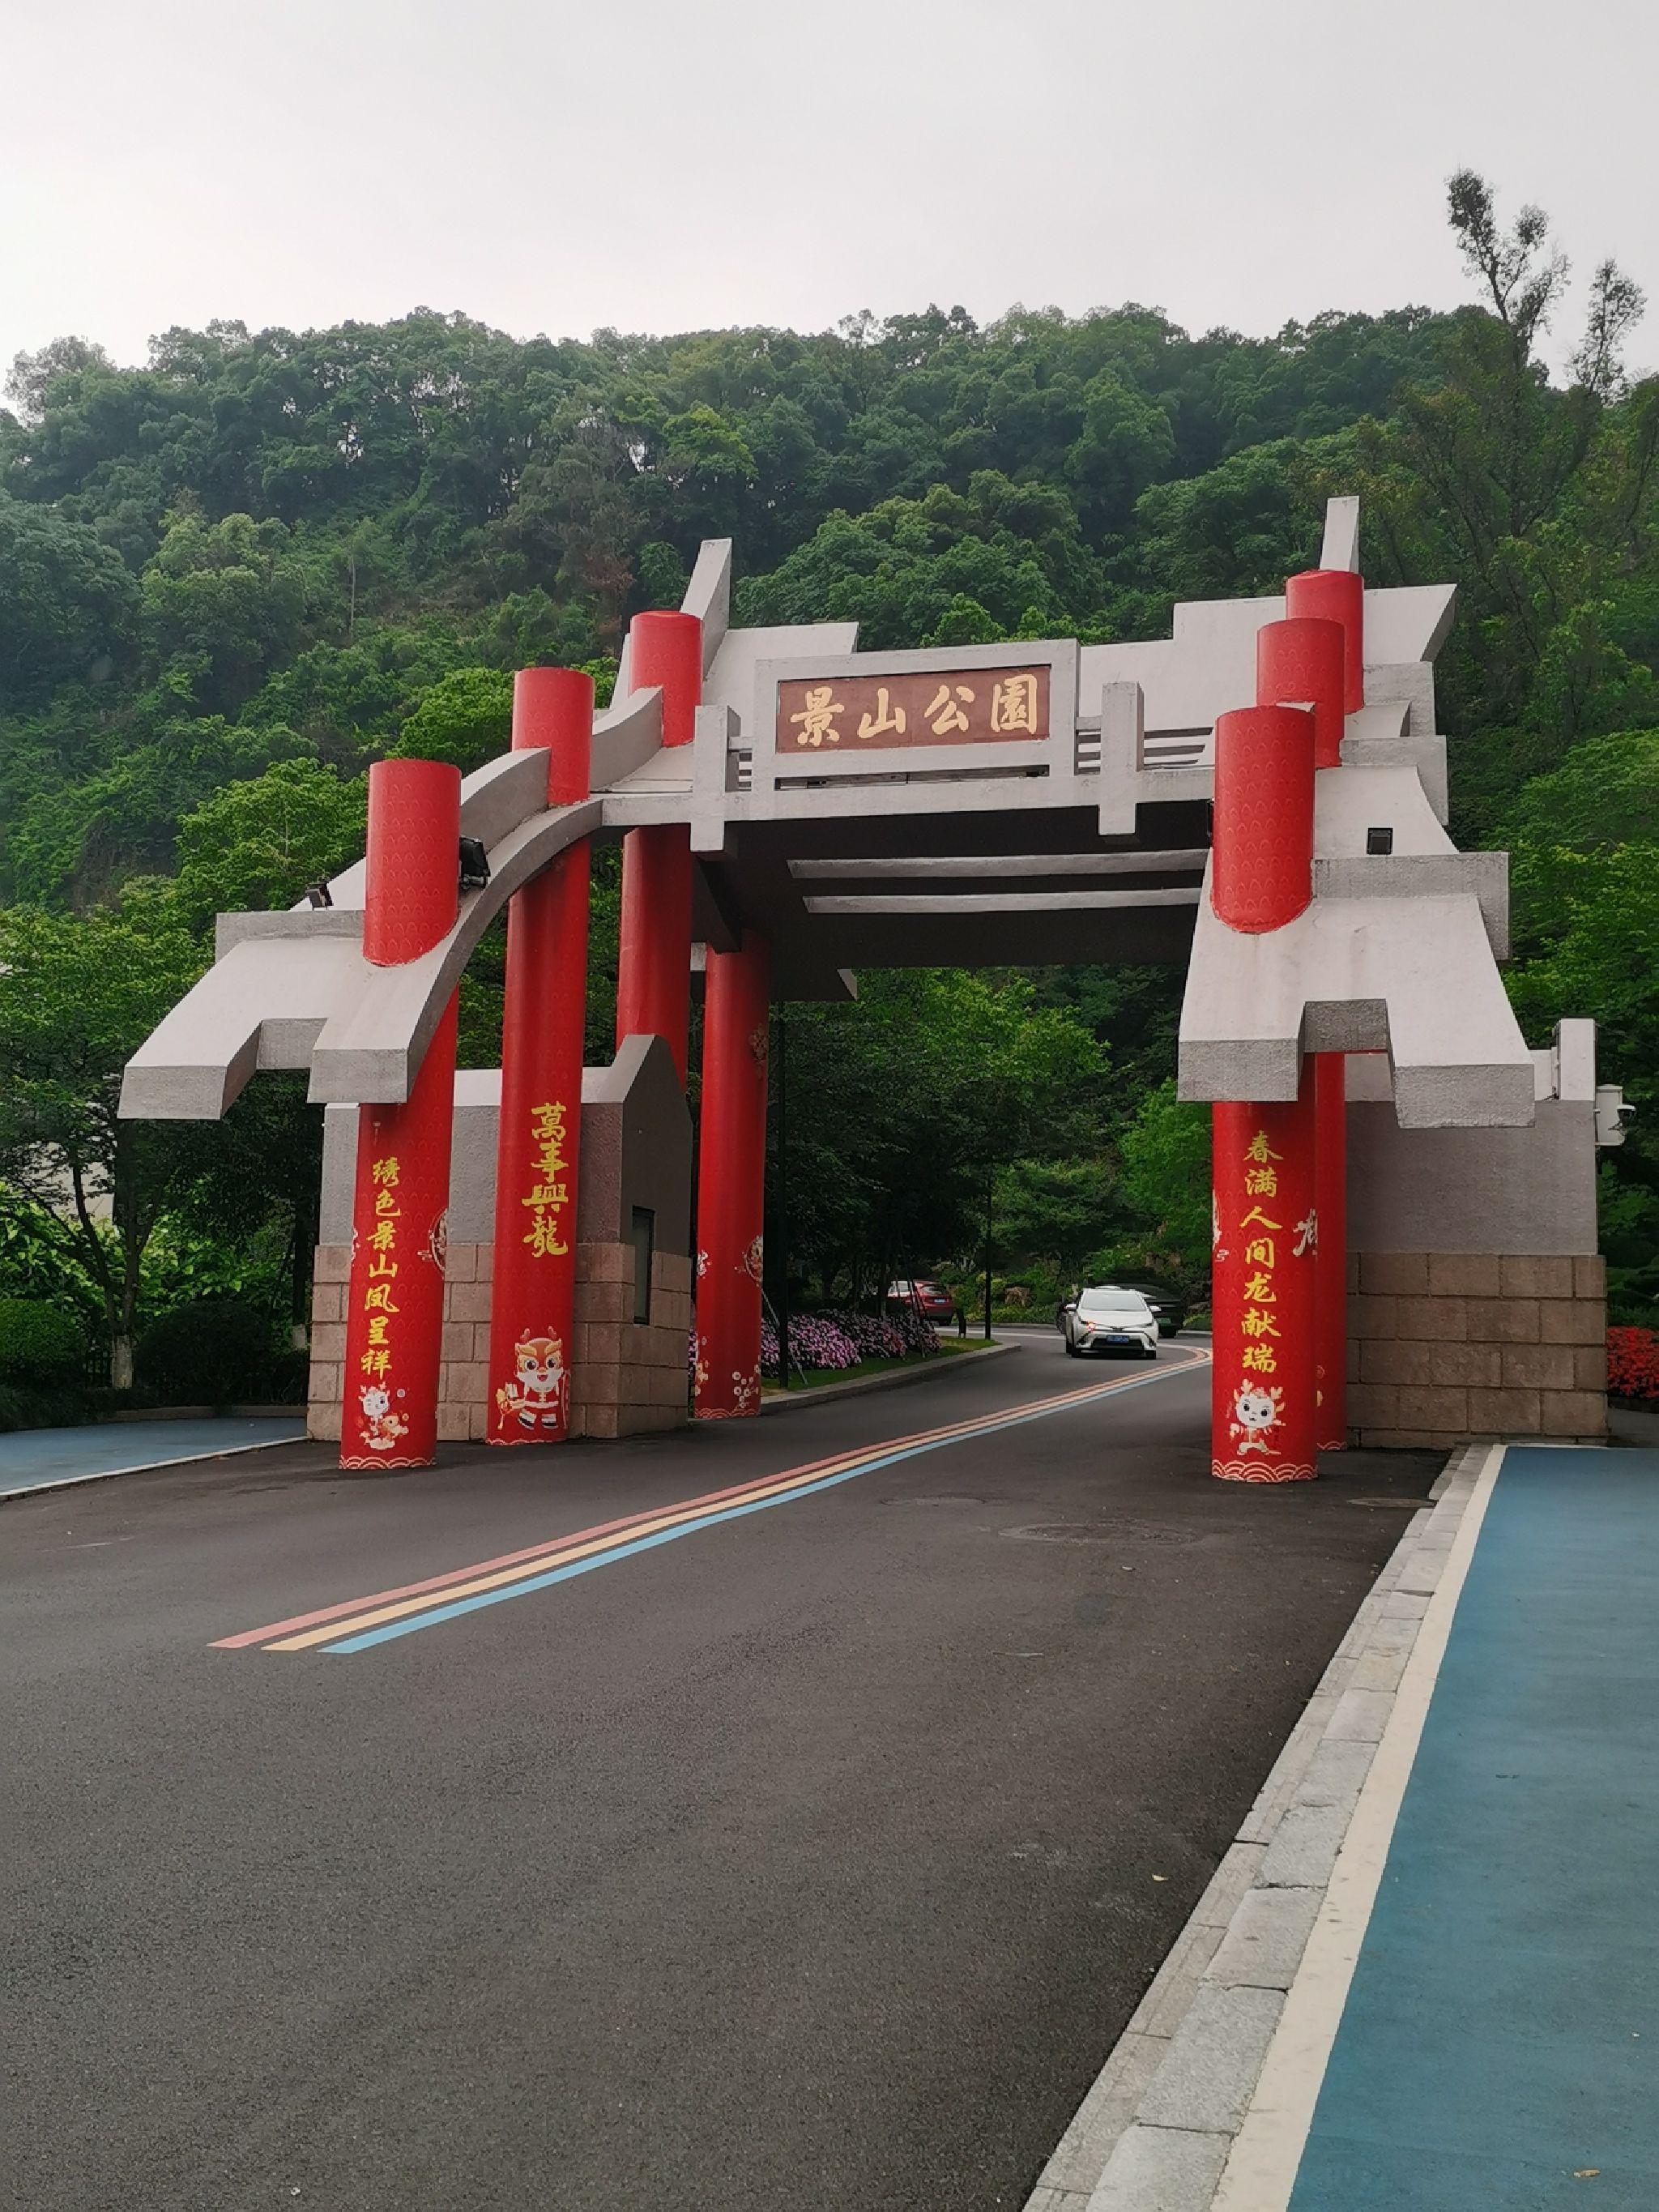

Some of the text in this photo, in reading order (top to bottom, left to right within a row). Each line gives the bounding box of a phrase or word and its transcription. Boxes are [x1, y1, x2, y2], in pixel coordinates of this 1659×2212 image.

[790, 673, 1038, 747] 景山公園
[1239, 1130, 1283, 1373] 春满人间龙献瑞
